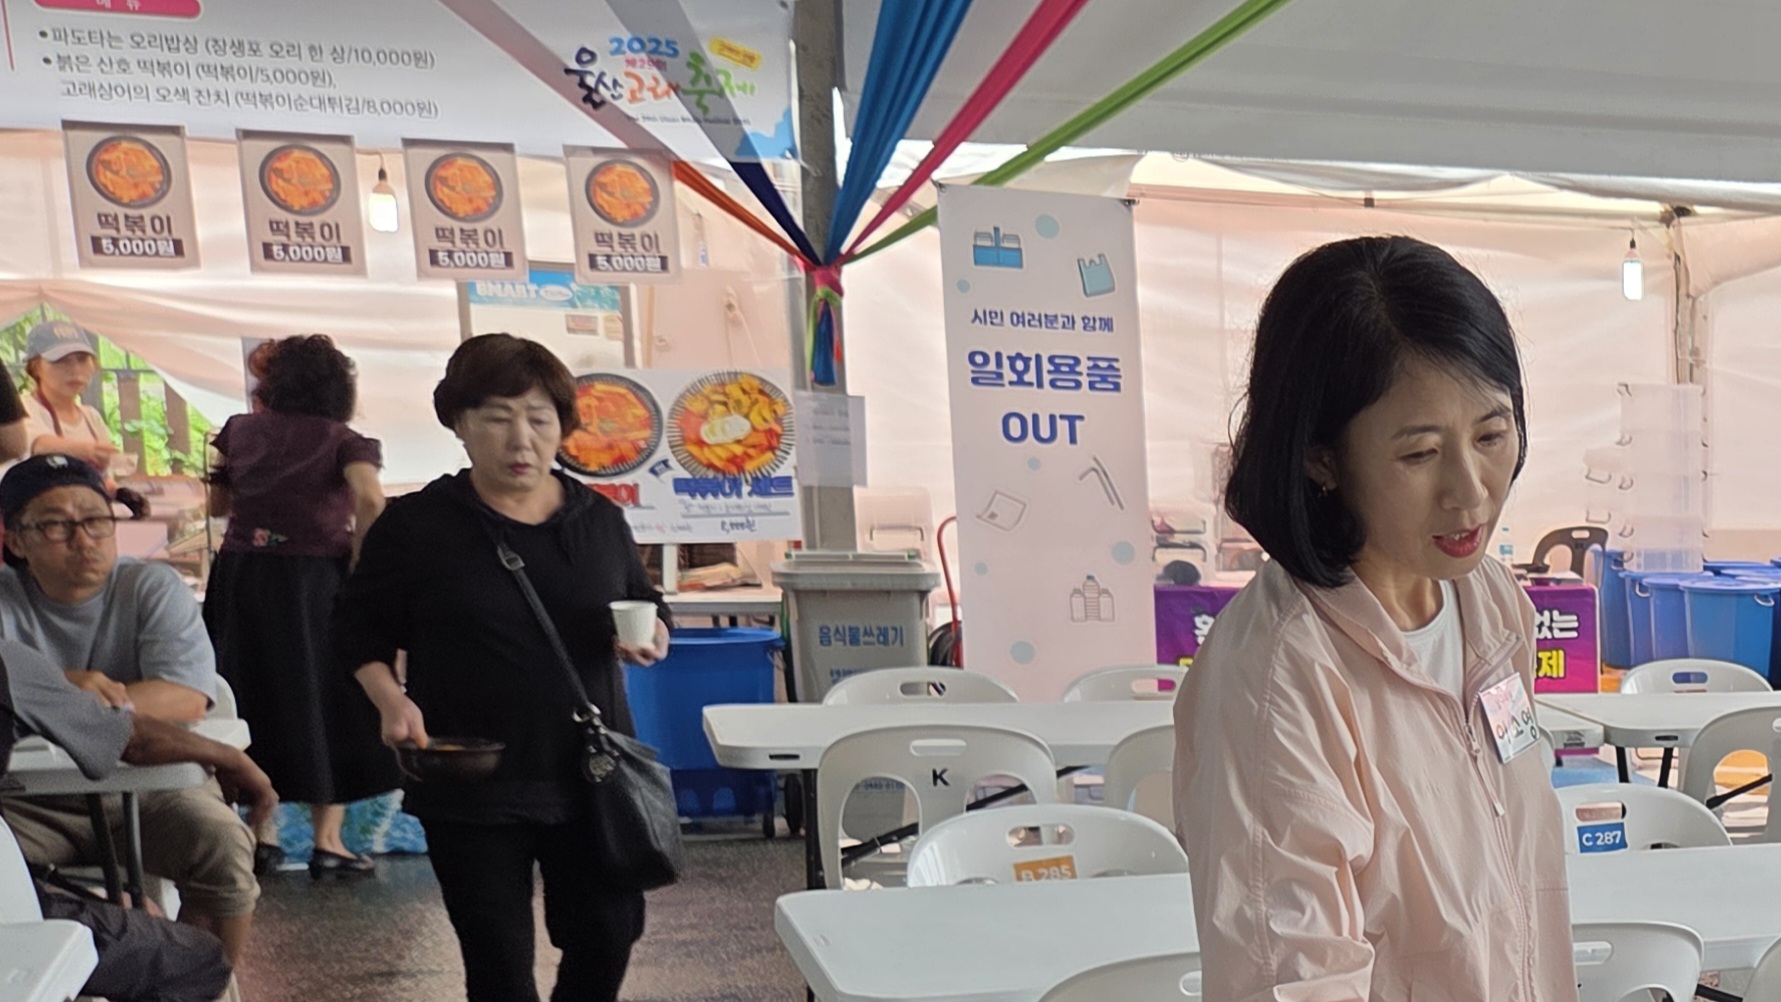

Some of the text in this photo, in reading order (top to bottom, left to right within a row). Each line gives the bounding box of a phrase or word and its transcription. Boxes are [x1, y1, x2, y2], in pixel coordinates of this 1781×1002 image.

[52, 27, 124, 49] 파도타는
[130, 32, 199, 55] 오리밥상
[269, 41, 302, 61] 오리
[308, 43, 324, 63] 한
[608, 35, 680, 59] 2025
[56, 53, 93, 74] 붉은
[99, 57, 133, 75] 산호
[137, 60, 191, 80] 떡볶이
[60, 80, 151, 102] 고래상어의
[155, 87, 191, 107] 오색
[194, 89, 231, 108] 잔치
[97, 212, 172, 237] 떡볶이
[269, 219, 342, 243] 떡볶이
[101, 238, 176, 257] 5,000원
[435, 227, 505, 250] 떡볶이
[594, 231, 660, 253] 떡볶이
[272, 244, 343, 263] 5,000원
[437, 251, 506, 268] 5,000원
[596, 255, 662, 272] 5,000원
[971, 308, 1114, 333] 시민 여러분과 함께
[967, 350, 1122, 393] 일회용품
[1001, 411, 1085, 445] OUT
[819, 625, 905, 647] 음식물쓰레기
[932, 769, 949, 787] K
[1582, 830, 1621, 847] C 287
